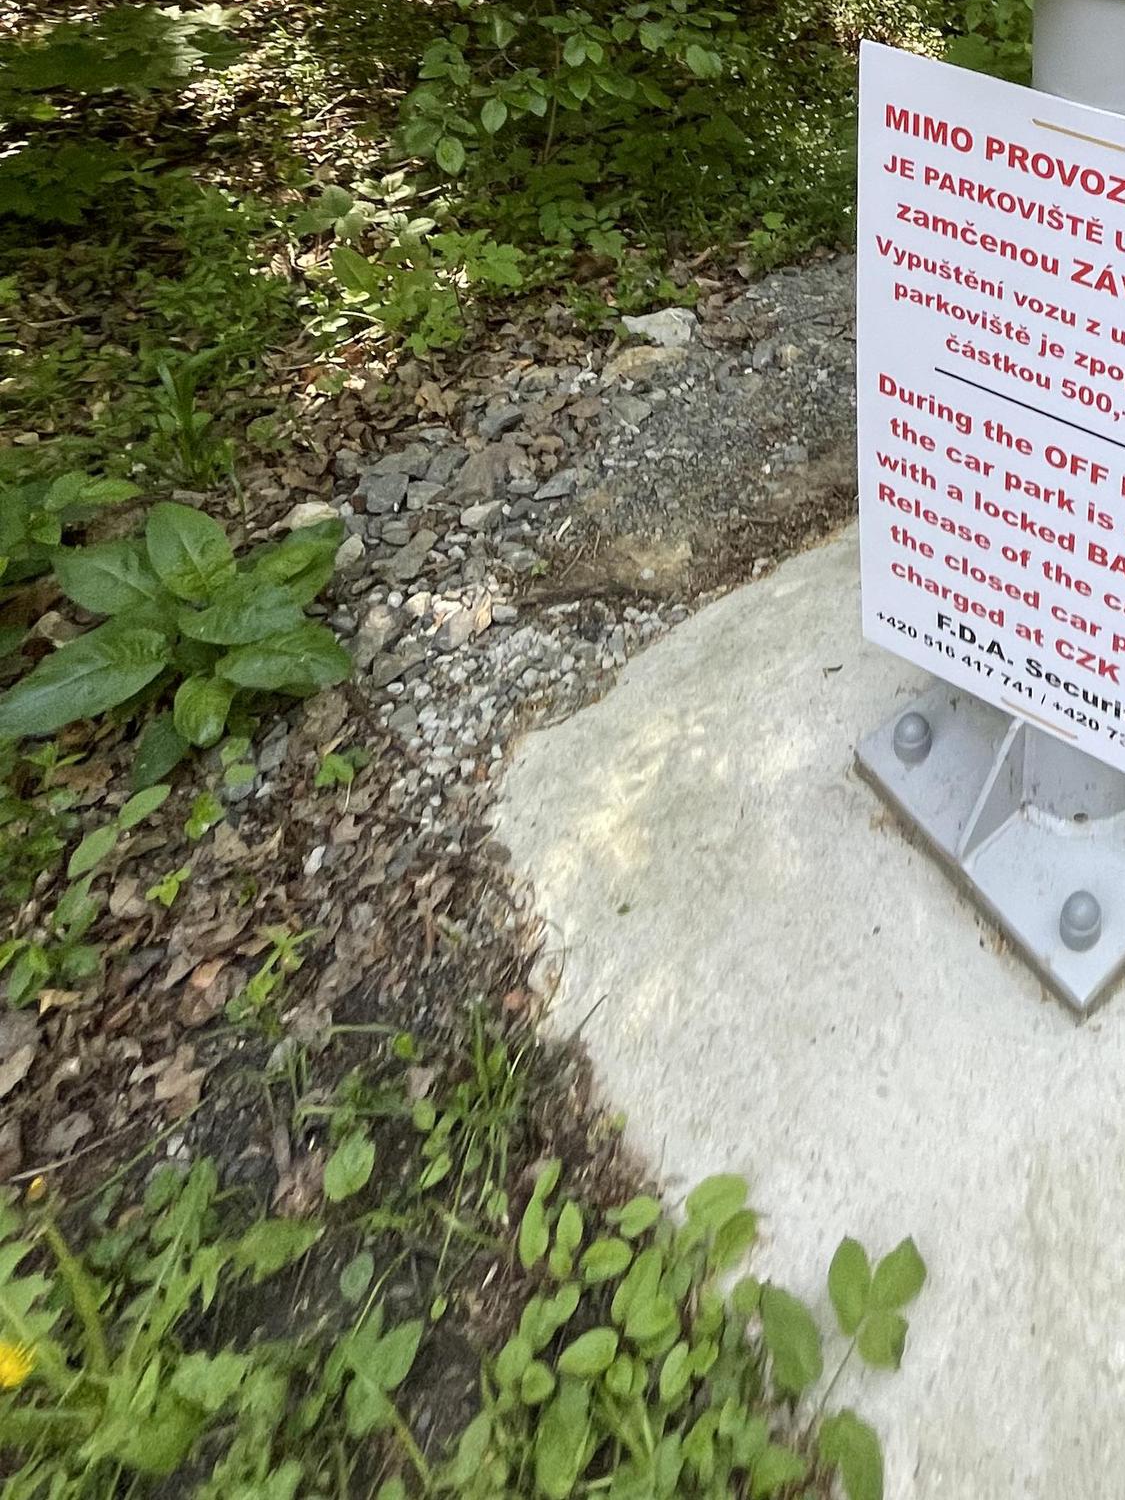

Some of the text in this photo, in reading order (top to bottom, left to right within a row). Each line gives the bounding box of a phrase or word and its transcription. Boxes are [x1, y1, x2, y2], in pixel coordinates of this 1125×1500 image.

[885, 103, 974, 153] MIMO
[883, 154, 915, 181] JE
[924, 165, 1104, 245] PARKOVIŠTĚ
[896, 202, 1060, 277] zamčenou
[875, 234, 1004, 301] Vypuštění
[1013, 290, 1077, 327] vozu
[1085, 318, 1101, 337] z
[894, 282, 1031, 346] parkoviště
[1037, 333, 1065, 359] je
[945, 333, 1051, 391] částkou
[879, 372, 972, 436] During
[982, 419, 1033, 456] the
[1044, 445, 1110, 485] OFF
[889, 417, 936, 452] the
[945, 446, 996, 478] car
[1004, 470, 1075, 515] park
[1087, 501, 1114, 531] is
[876, 451, 937, 491] with
[946, 484, 963, 504] a
[974, 490, 1076, 554] locked
[878, 481, 991, 550] Release
[1001, 545, 1032, 570] of
[1041, 560, 1092, 597] the
[890, 524, 935, 559] the
[944, 554, 1040, 611] closed
[1050, 605, 1103, 638] car
[891, 562, 1005, 628] charged
[1015, 622, 1045, 648] at
[1055, 638, 1120, 685] CZK
[876, 611, 918, 639] +420
[923, 633, 956, 659] 516
[961, 655, 994, 678] 417
[1000, 672, 1033, 699] 741
[1040, 693, 1047, 705] /
[1052, 701, 1100, 732] +420
[937, 611, 1014, 666] F.D.A.
